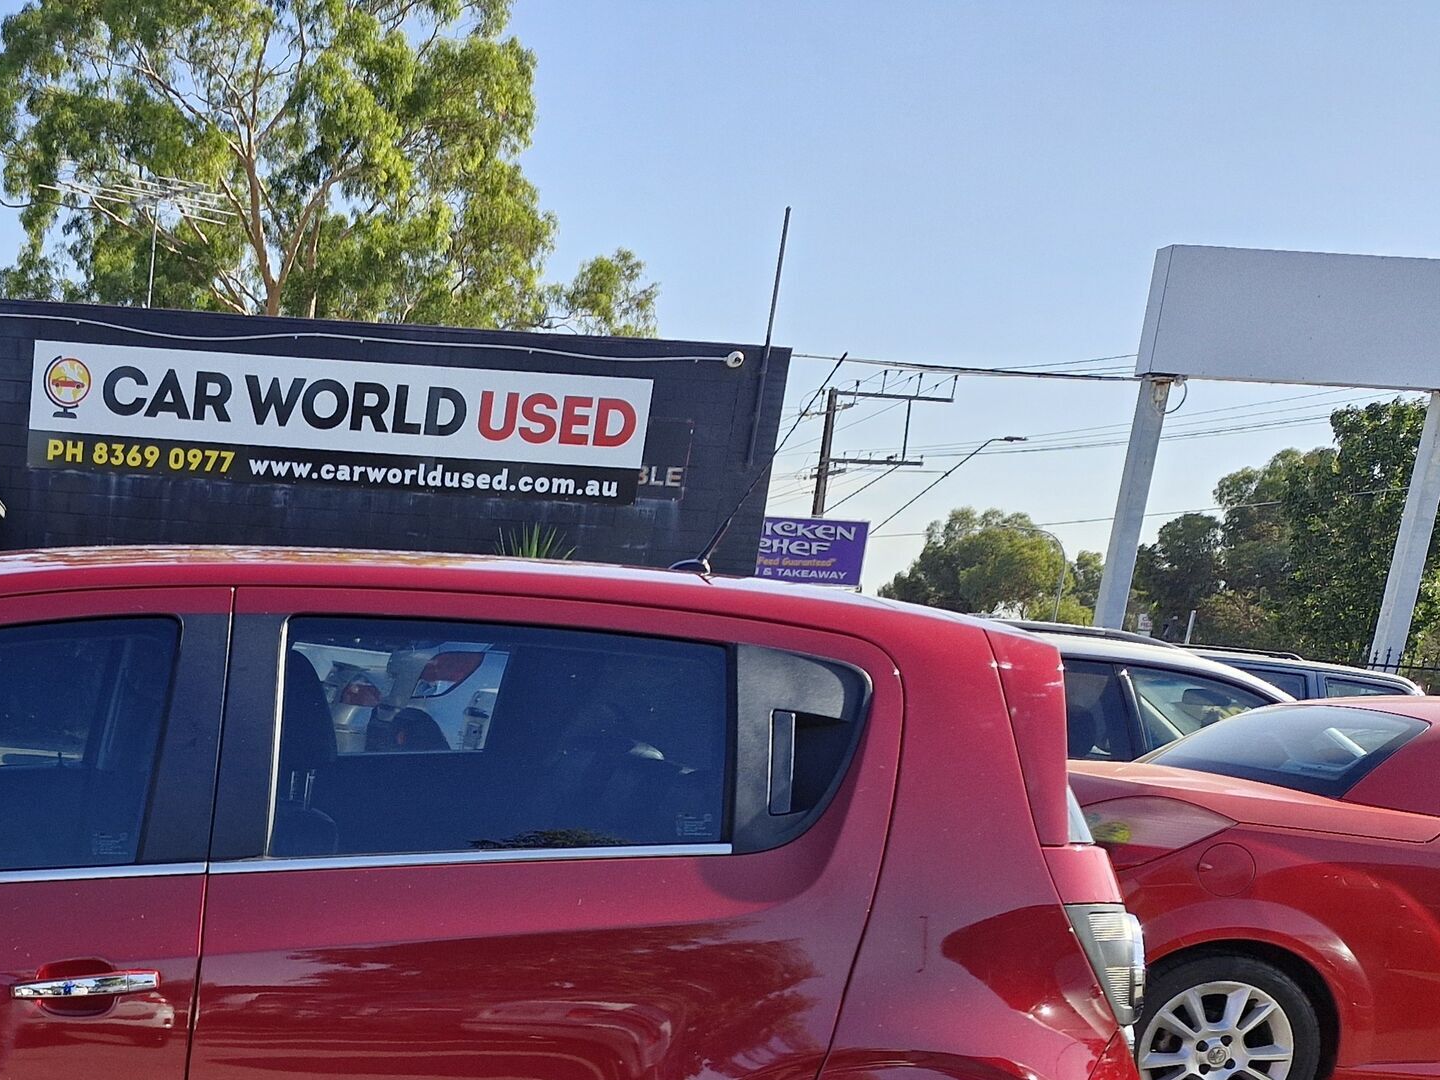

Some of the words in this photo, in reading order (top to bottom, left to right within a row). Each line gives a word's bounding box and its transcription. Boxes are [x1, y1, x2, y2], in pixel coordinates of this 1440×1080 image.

[102, 366, 232, 422] CAR
[245, 375, 467, 437] WORLD
[477, 390, 637, 448] USED
[47, 439, 84, 463] PH
[92, 442, 160, 468] 8369
[168, 447, 236, 473] 0977
[248, 459, 618, 498] www.carworldused.com.au
[776, 568, 847, 579] TAKEAWAY
